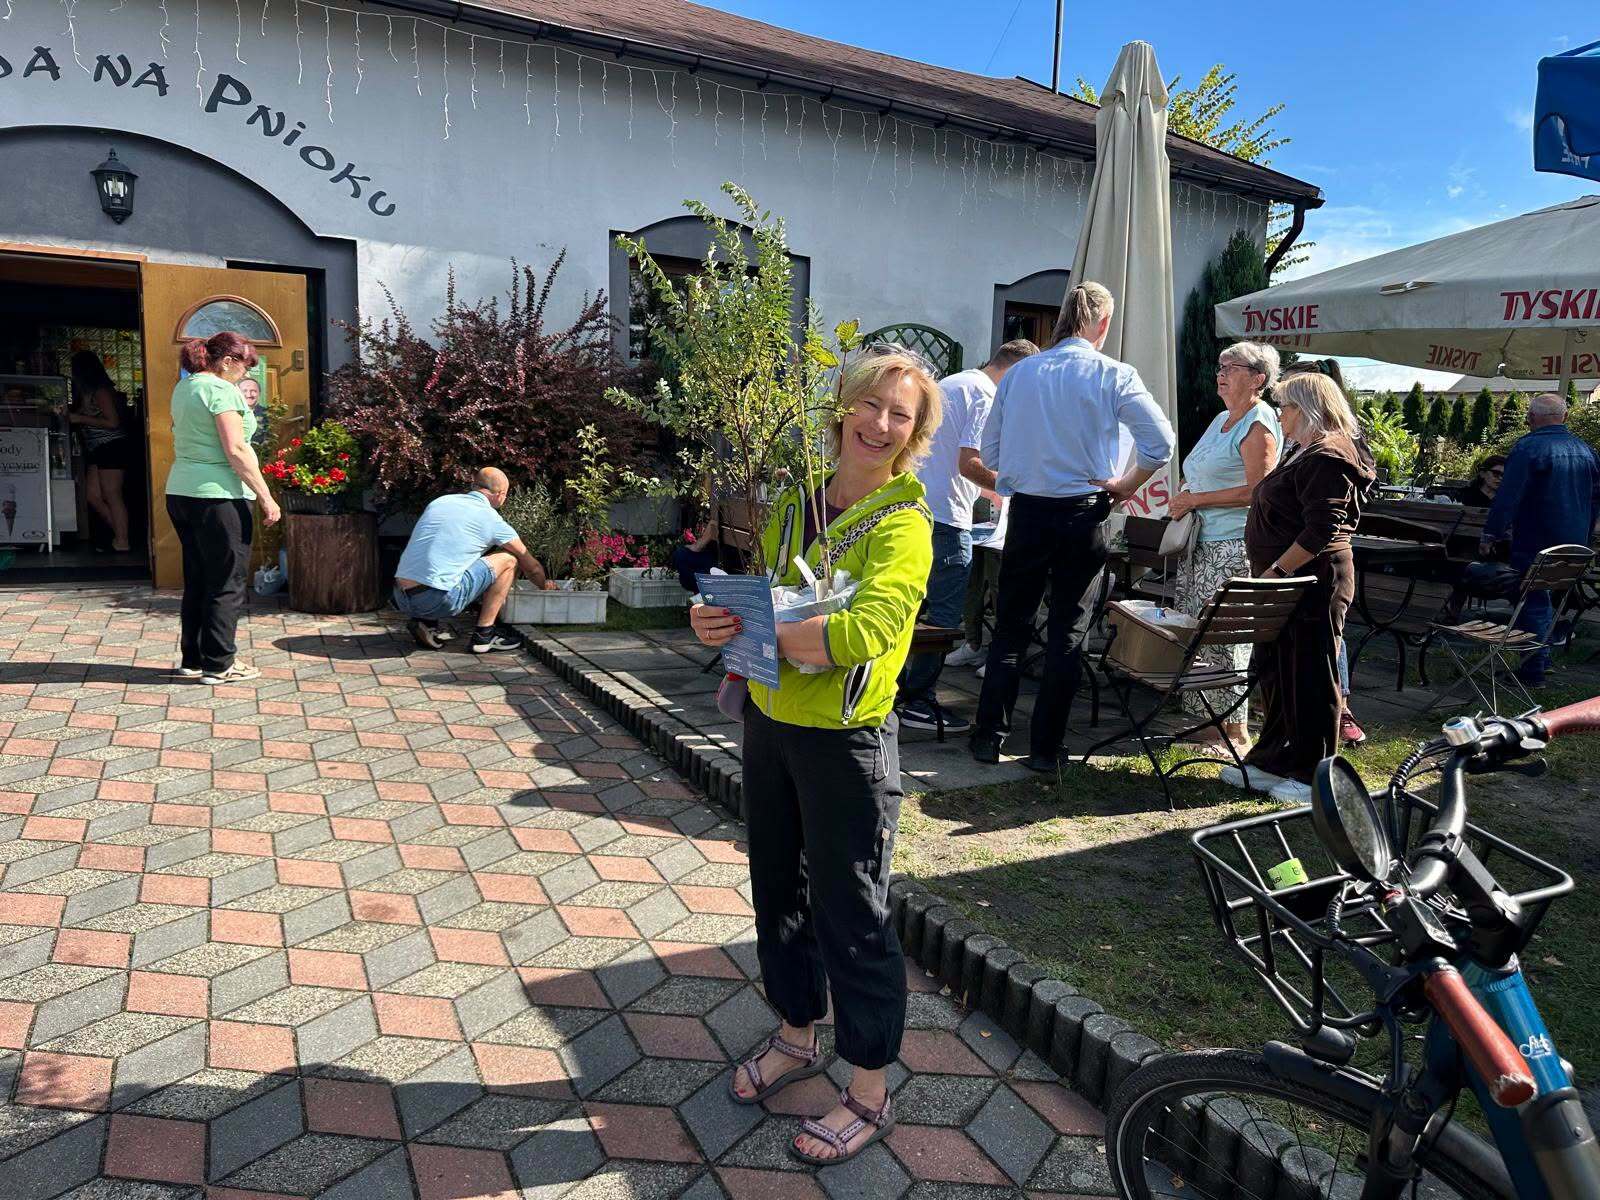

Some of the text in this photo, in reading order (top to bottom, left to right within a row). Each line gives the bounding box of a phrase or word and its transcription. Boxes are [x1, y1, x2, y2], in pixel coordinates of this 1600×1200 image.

[93, 54, 170, 97] NA
[1242, 304, 1319, 333] TYSKIE
[1500, 288, 1600, 321] TYSKI
